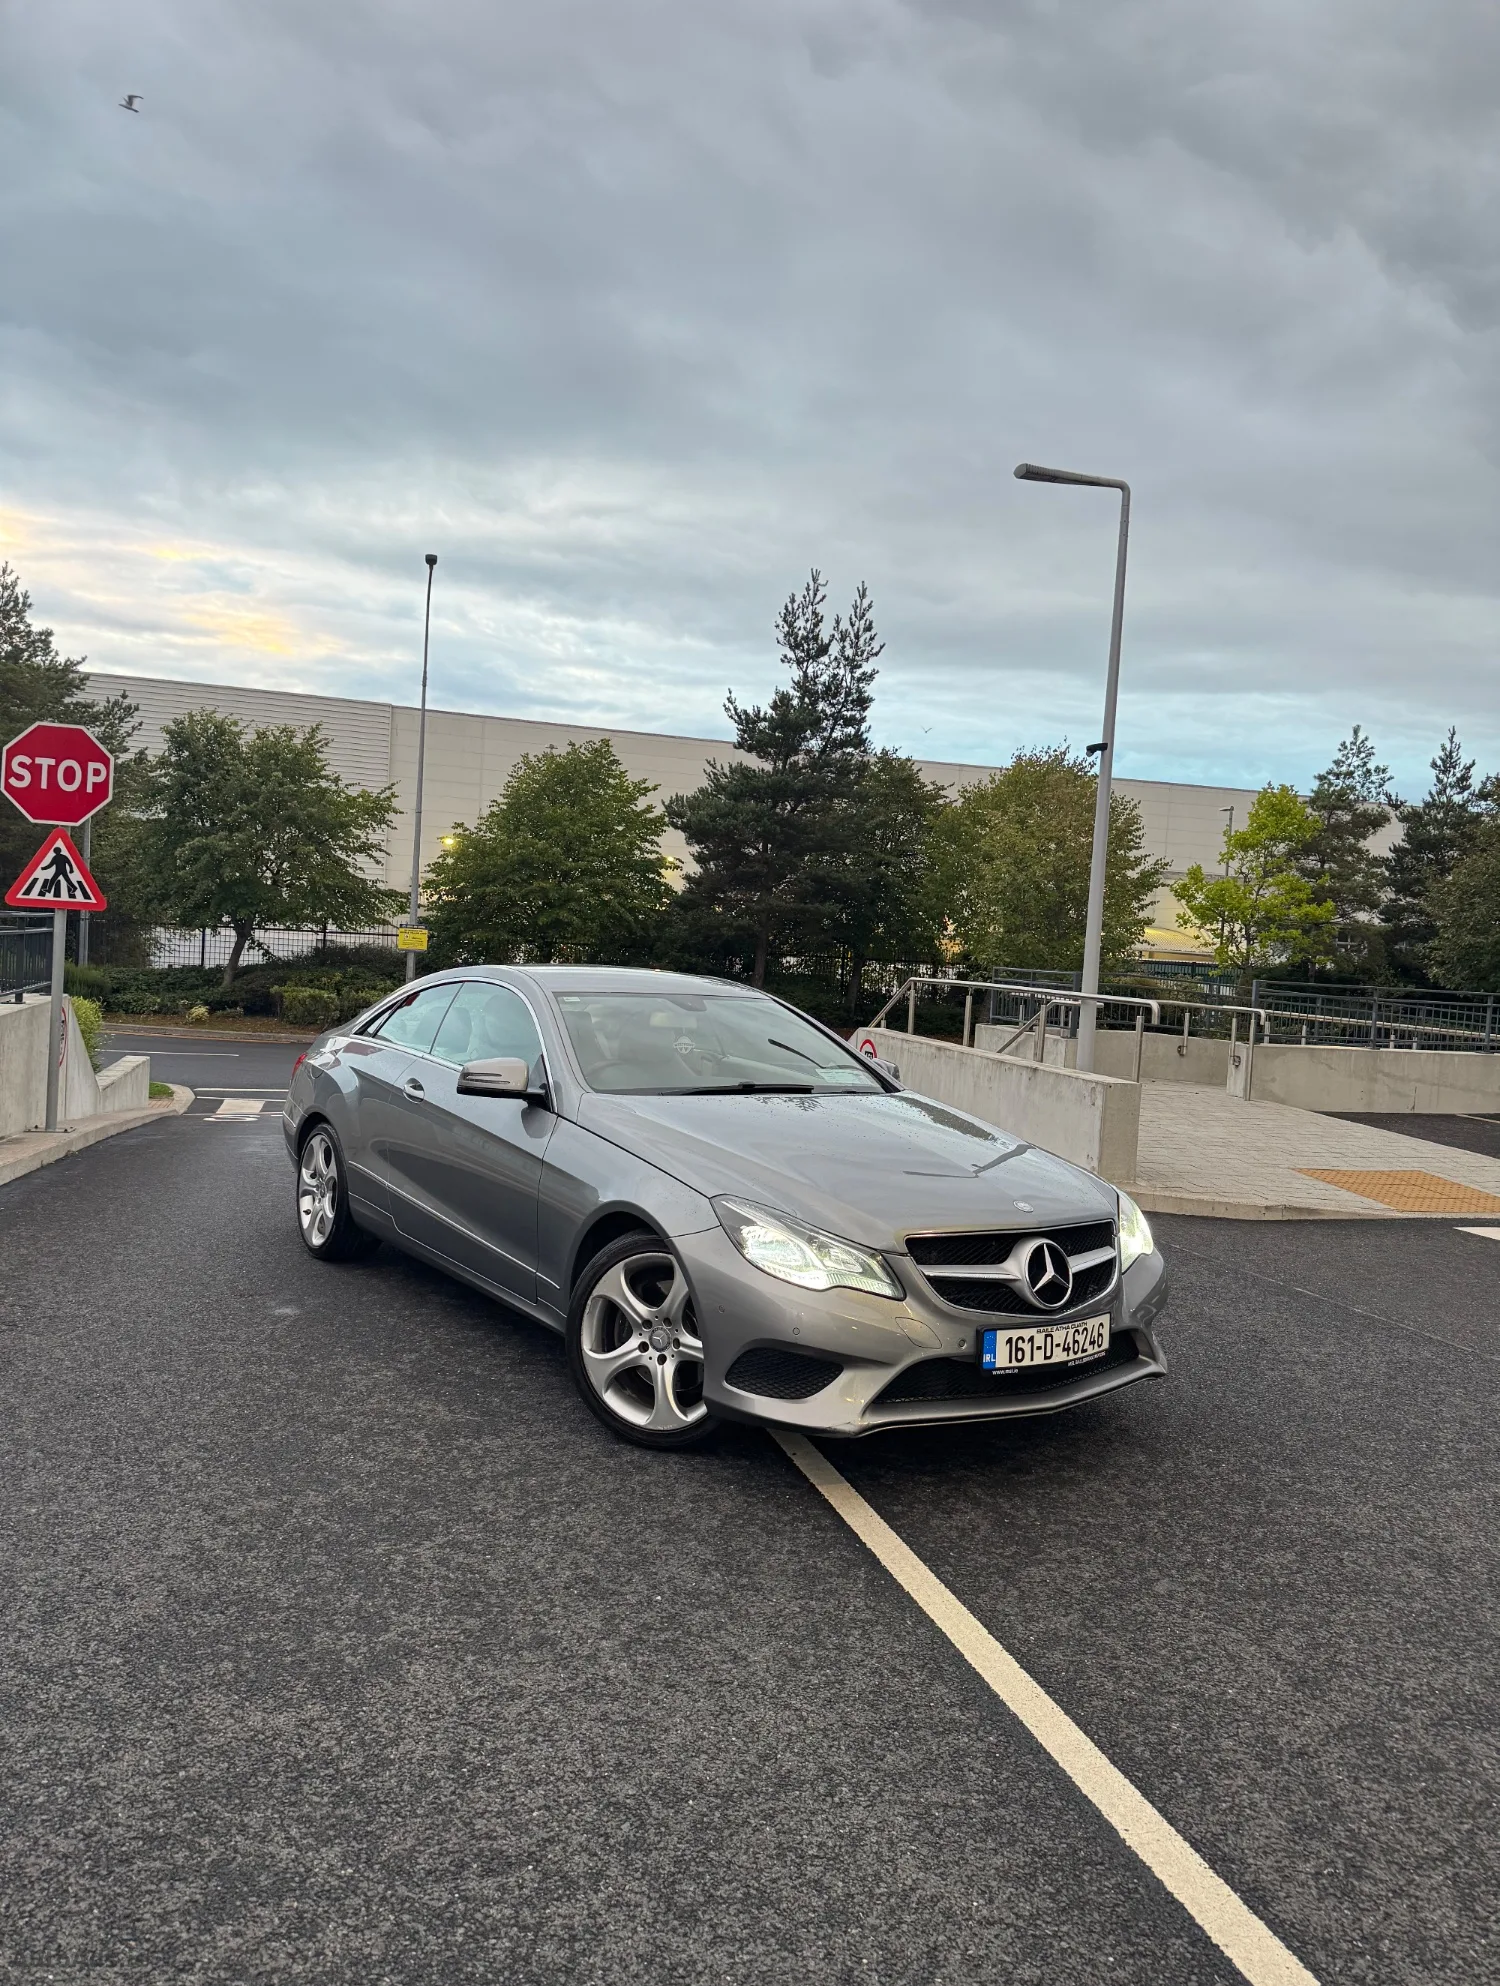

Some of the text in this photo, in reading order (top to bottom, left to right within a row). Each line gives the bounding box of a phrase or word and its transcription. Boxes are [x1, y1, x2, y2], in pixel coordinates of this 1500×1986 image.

[8, 755, 107, 793] STOP
[983, 1353, 996, 1363] IRL
[1005, 1322, 1105, 1364] 161-D-46246
